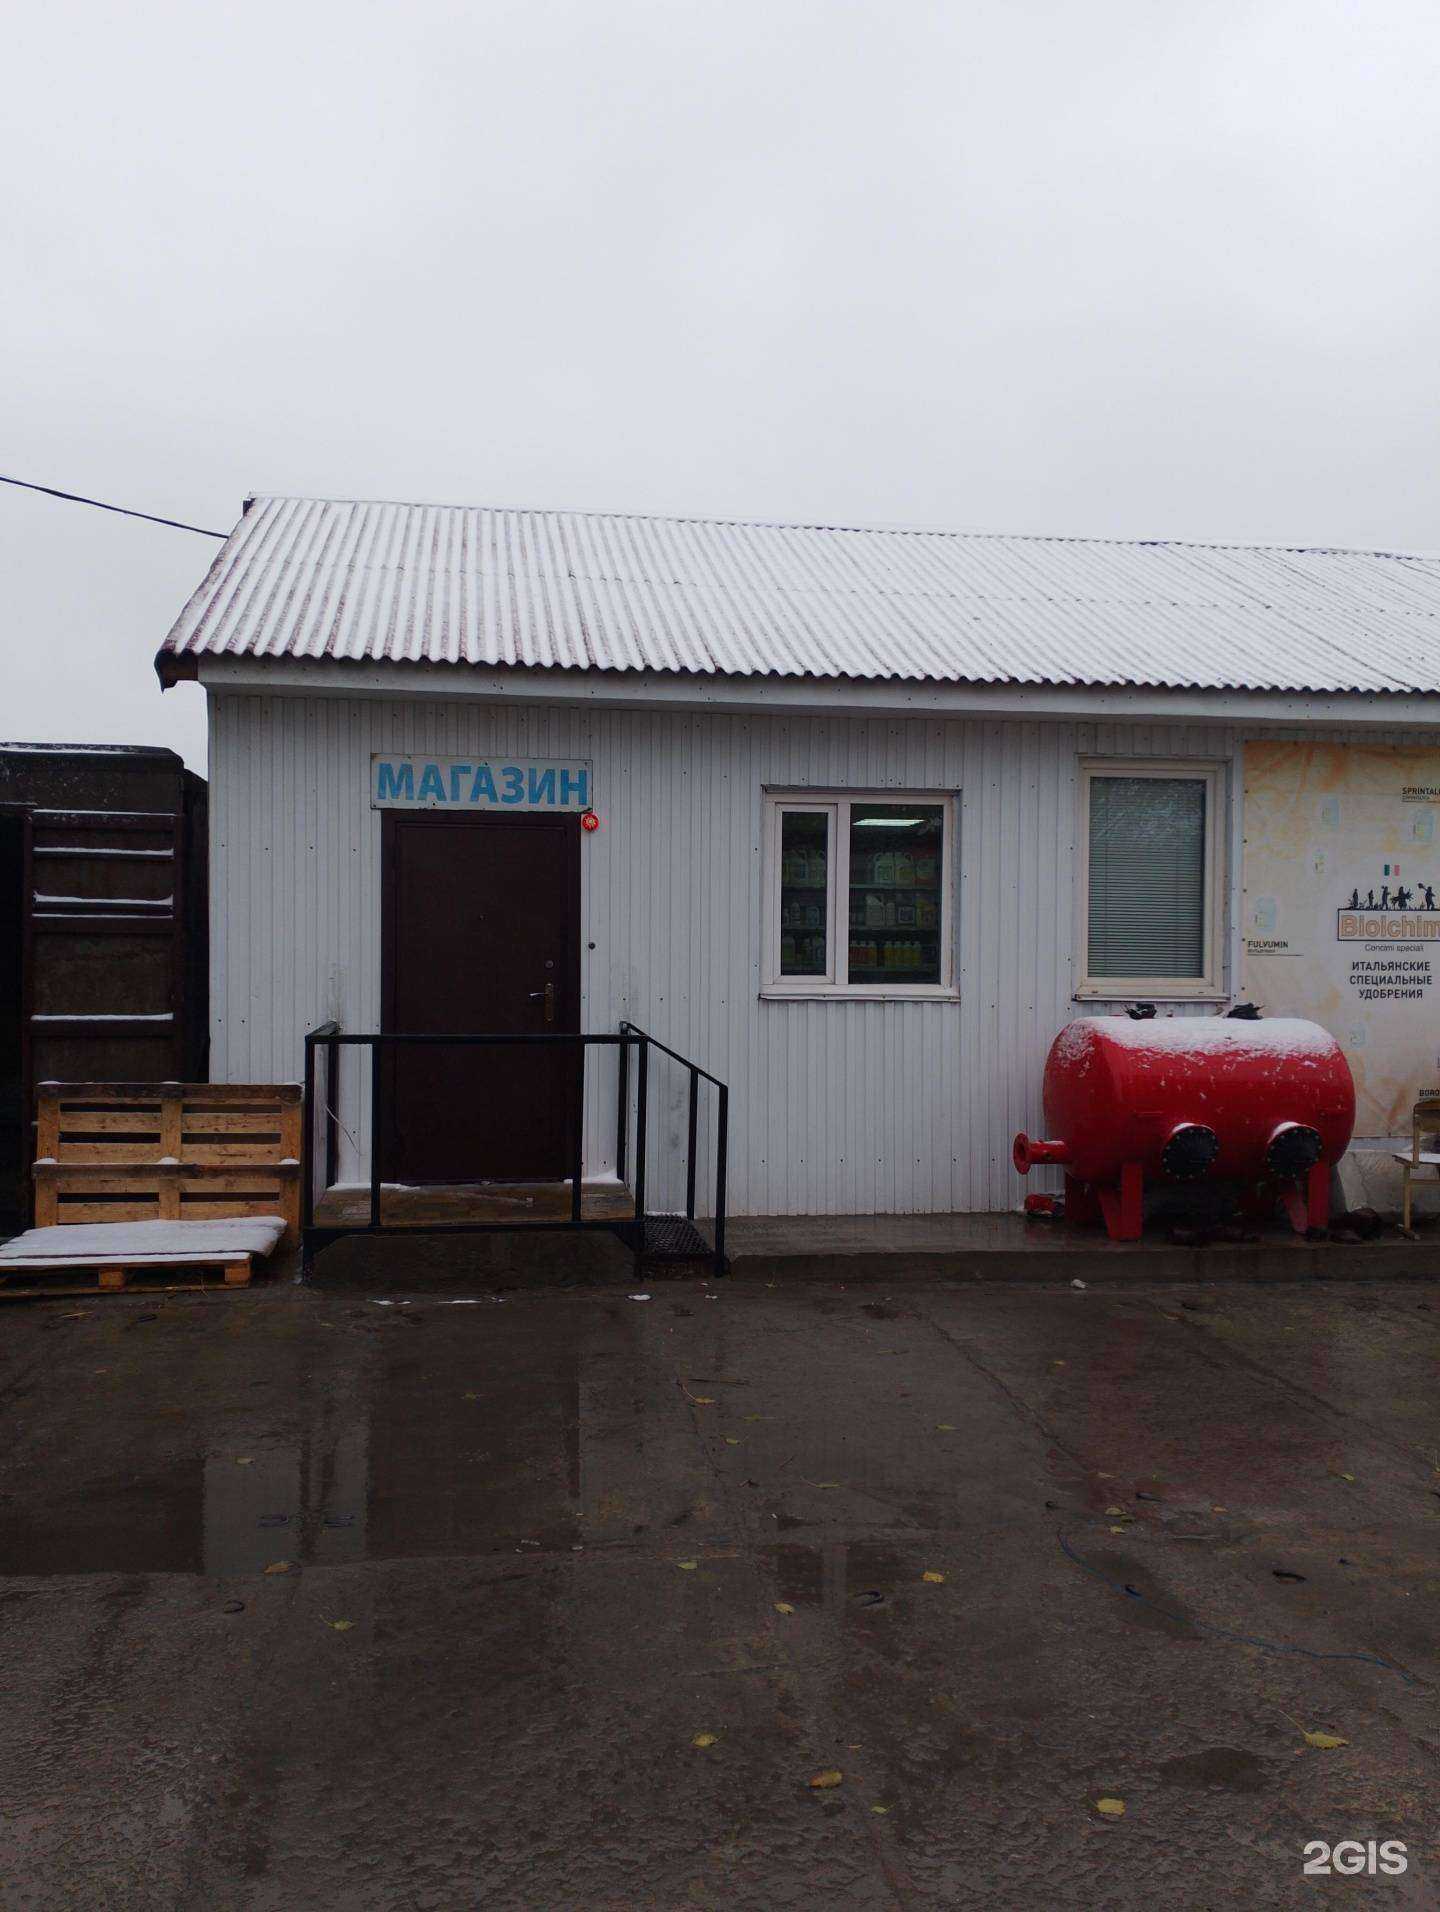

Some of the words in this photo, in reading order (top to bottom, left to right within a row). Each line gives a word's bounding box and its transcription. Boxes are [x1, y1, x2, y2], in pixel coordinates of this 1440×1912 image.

[377, 762, 588, 806] МАГАЗИН
[1402, 787, 1440, 796] SPRINTAL
[1341, 914, 1440, 938] Biolchim
[1352, 961, 1431, 971] ИТАЛЬЯНСКИЕ
[1349, 975, 1432, 986] СПЕЦИАЛЬНЫЕ
[1359, 989, 1423, 1000] УДОБРЕНИЯ
